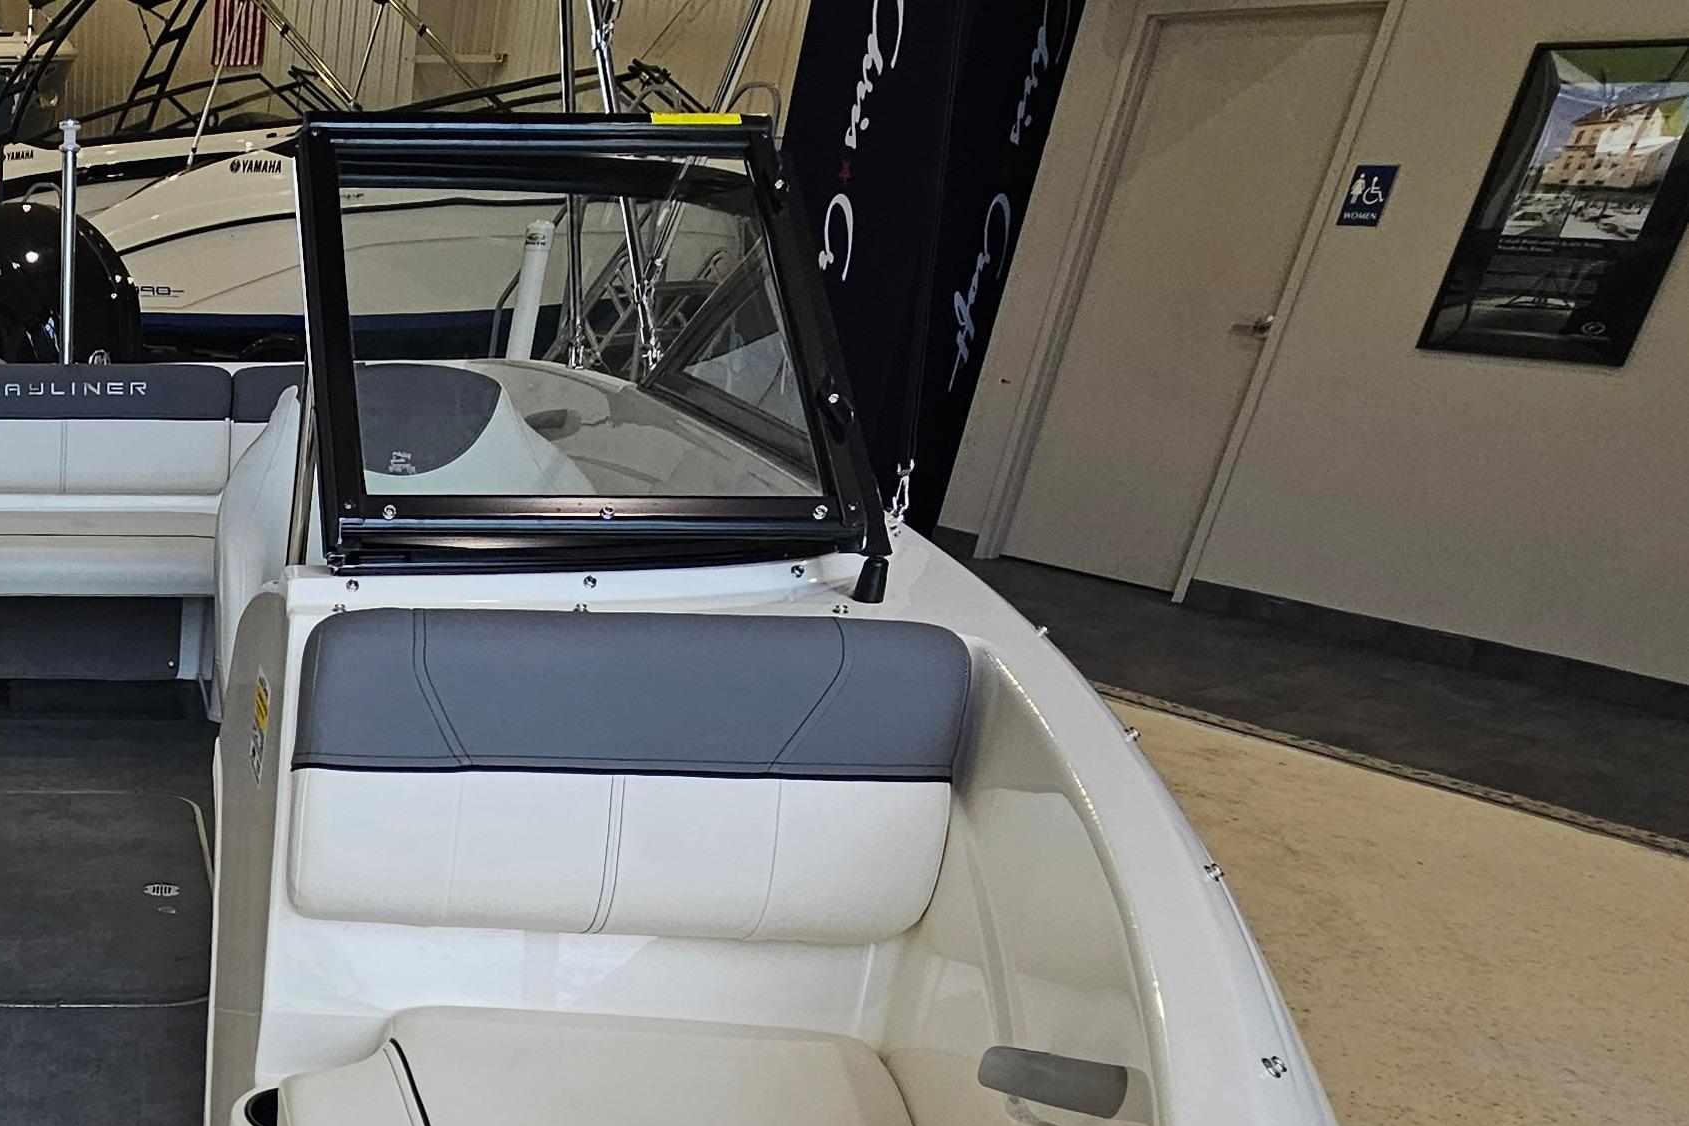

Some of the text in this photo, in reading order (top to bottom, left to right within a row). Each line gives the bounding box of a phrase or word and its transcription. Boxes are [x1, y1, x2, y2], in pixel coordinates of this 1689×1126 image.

[6, 150, 34, 161] YAMAHA
[242, 159, 282, 173] YAMAHA
[1343, 212, 1377, 220] WOMEN
